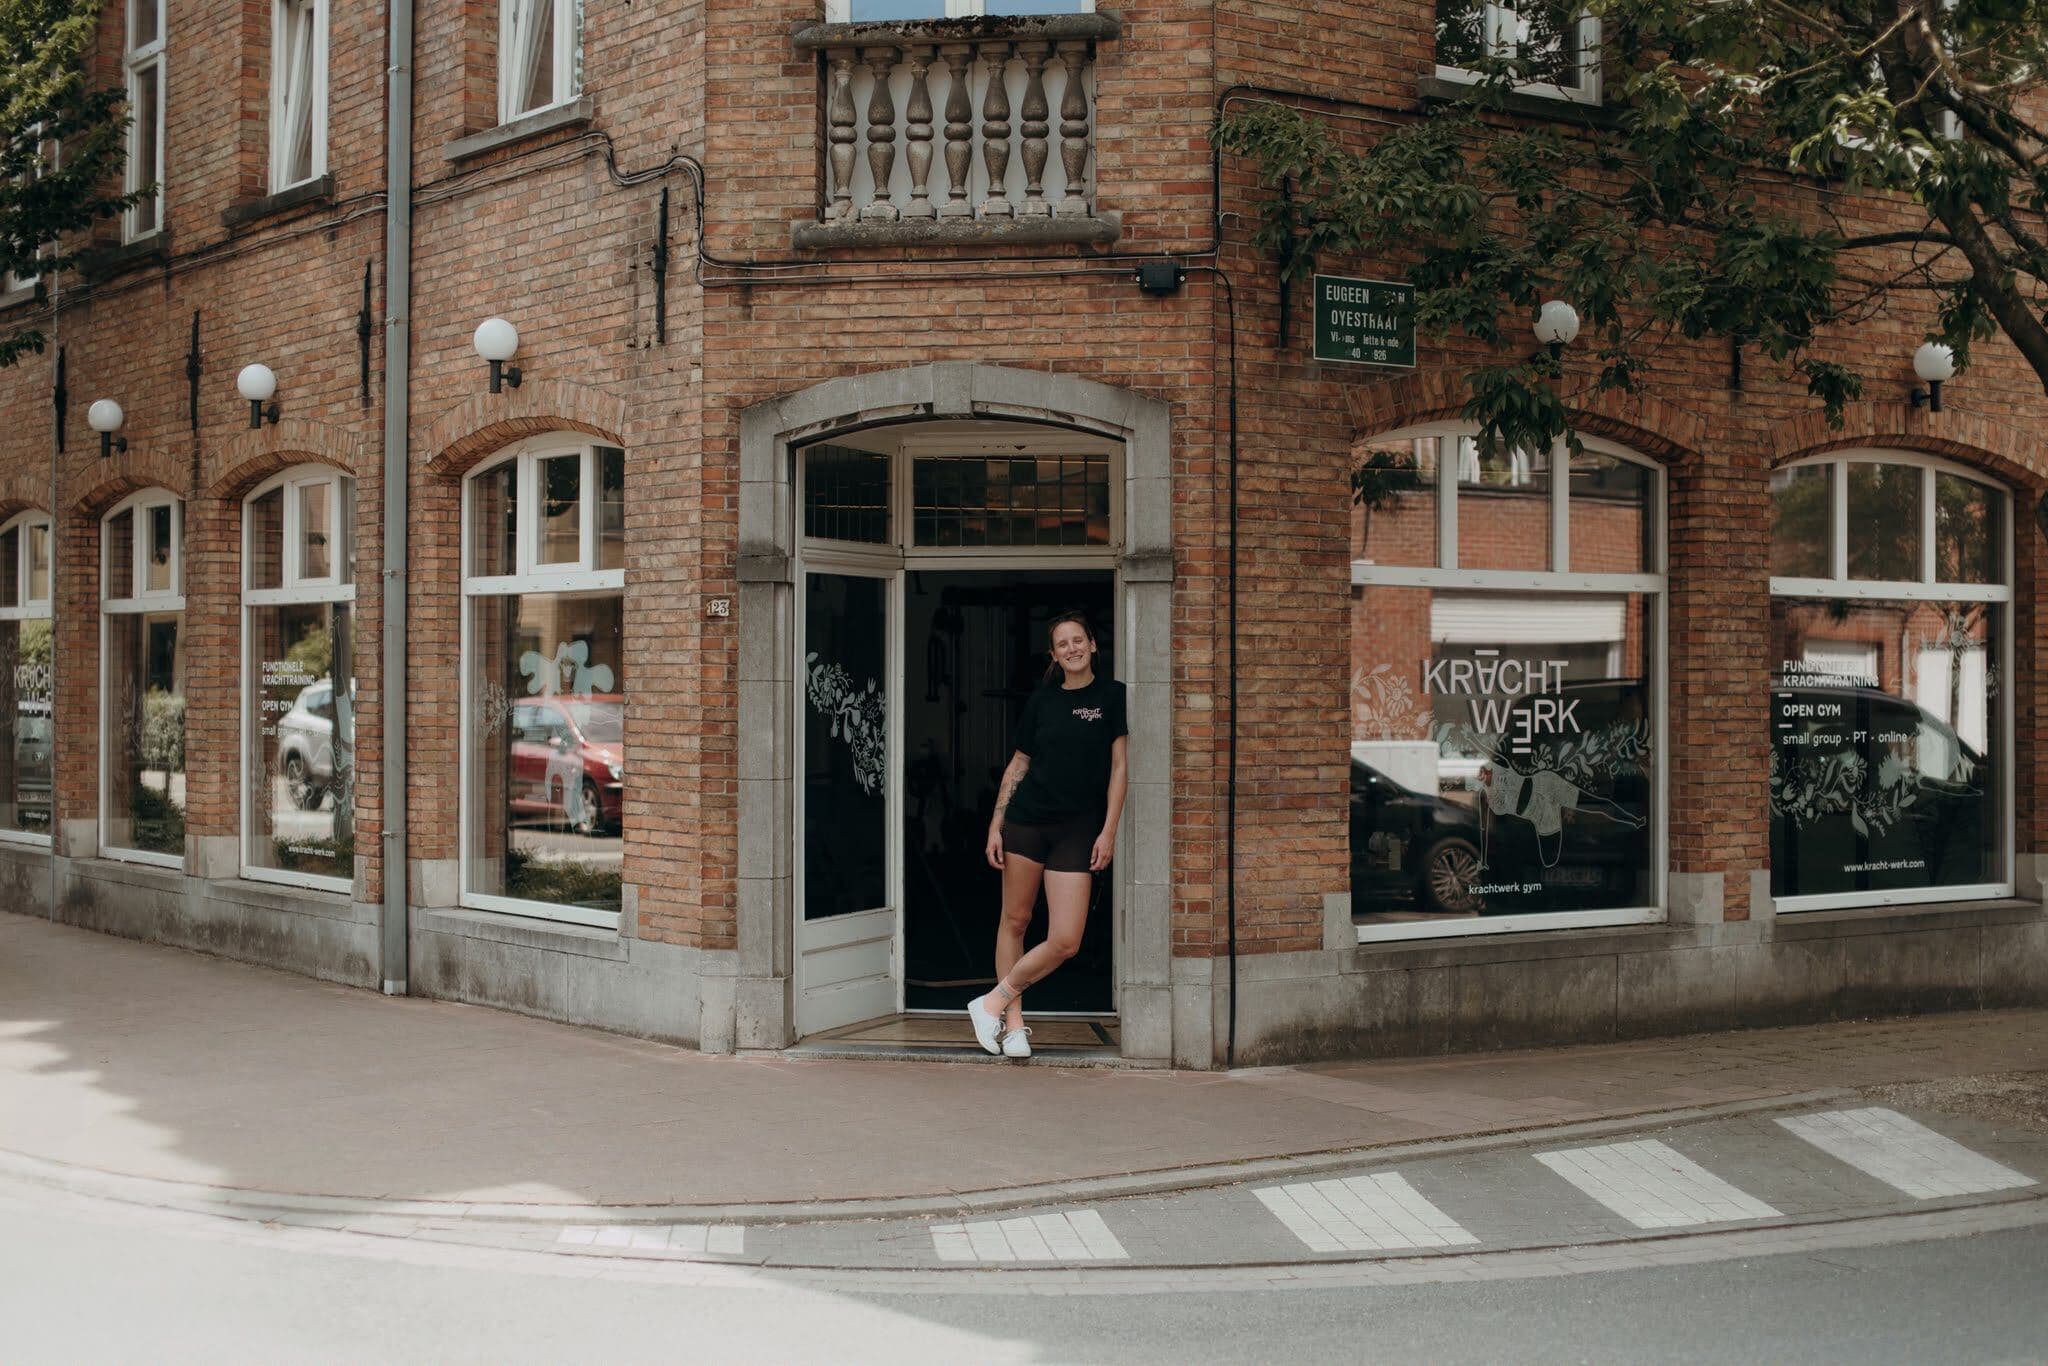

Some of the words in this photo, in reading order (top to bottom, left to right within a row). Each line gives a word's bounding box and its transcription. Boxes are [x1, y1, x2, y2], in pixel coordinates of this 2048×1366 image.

[1326, 285, 1369, 304] EUGEEN
[1331, 309, 1398, 331] OYESTRAAT
[1372, 349, 1387, 361] 926
[708, 601, 727, 614] 123
[13, 664, 51, 689] KRACH
[261, 700, 278, 711] OPEN
[1783, 704, 1814, 717] OPEN
[1817, 704, 1841, 717] GYM
[1783, 732, 1809, 745] small
[1813, 733, 1842, 747] group
[1853, 731, 1867, 744] PT
[1878, 730, 1908, 743] online
[1843, 859, 1925, 873] www.kracht-werk.com
[1468, 882, 1520, 895] krachtwerk
[1522, 882, 1542, 894] gym
